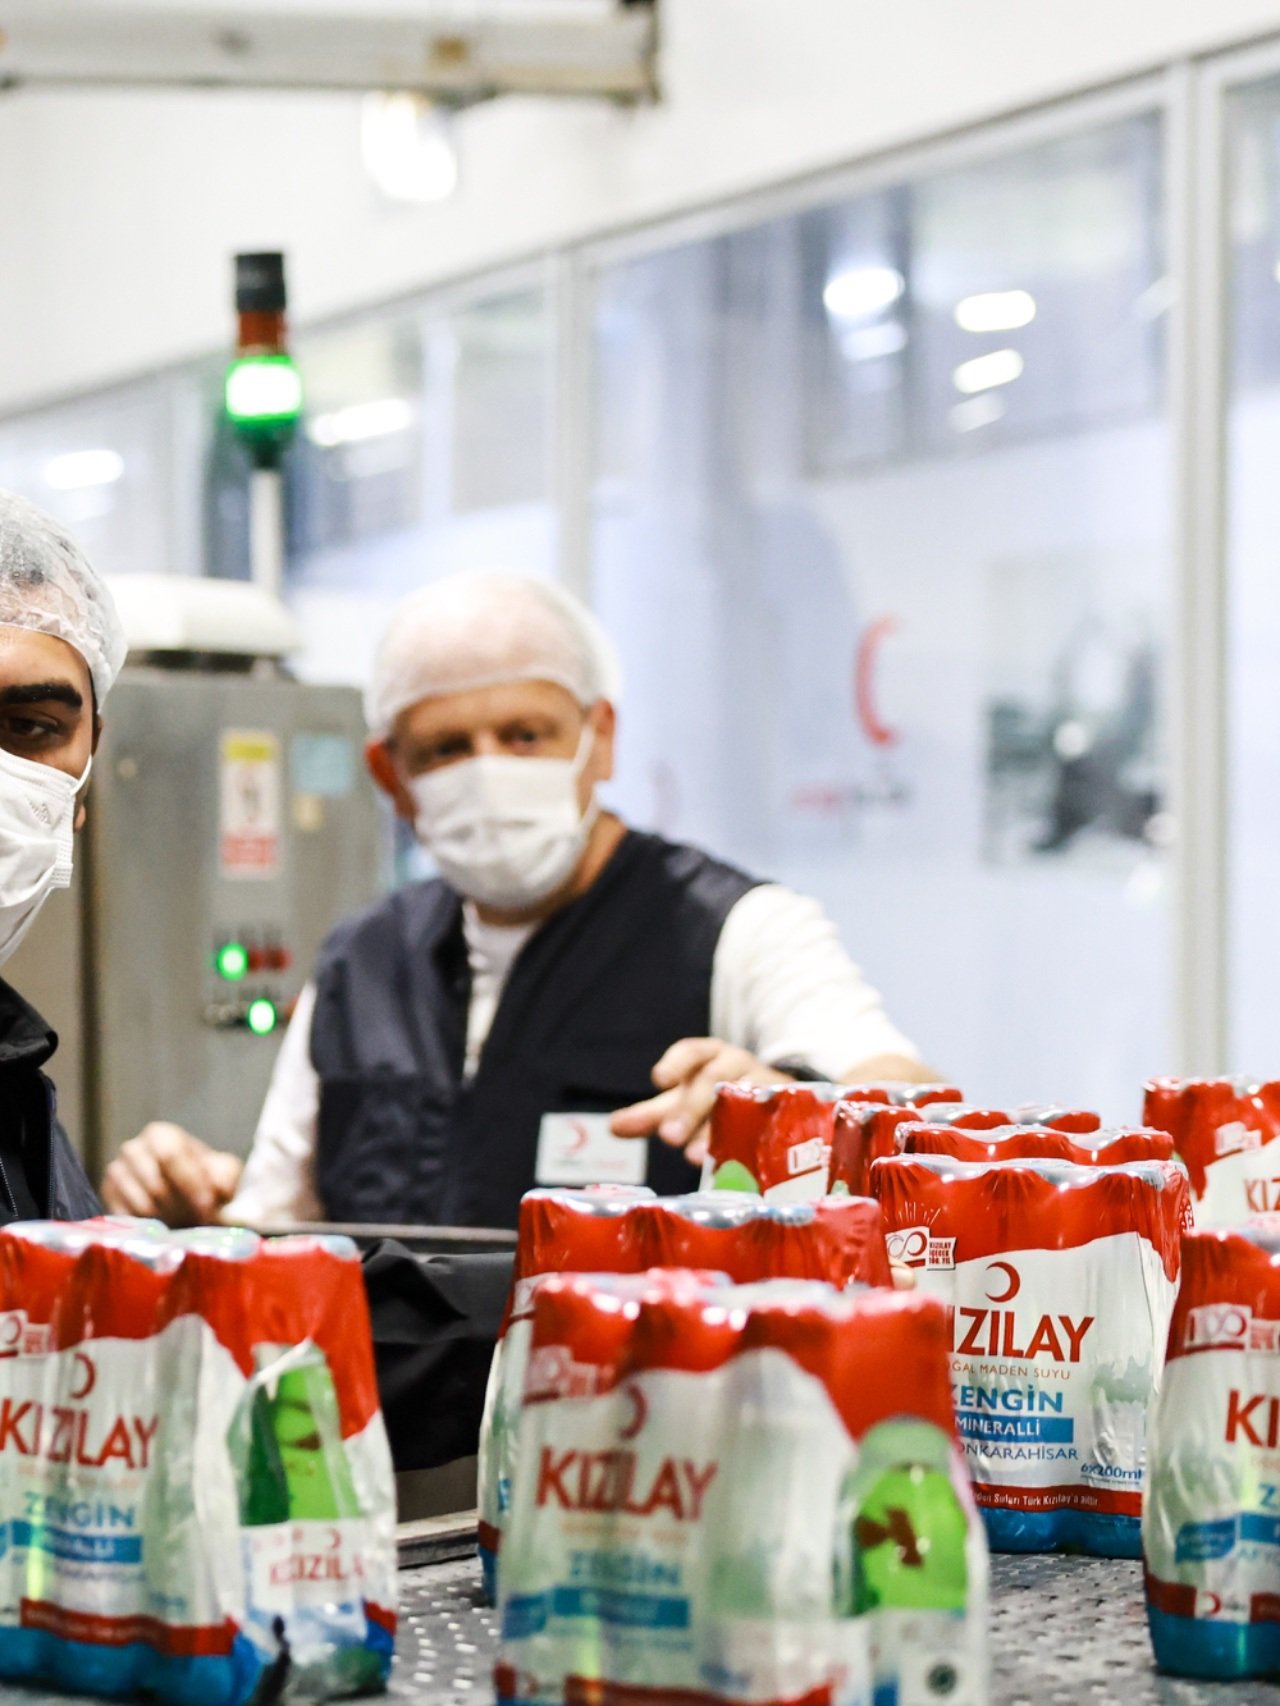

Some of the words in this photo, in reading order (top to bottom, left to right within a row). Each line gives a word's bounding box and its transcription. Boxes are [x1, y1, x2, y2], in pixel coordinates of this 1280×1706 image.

[946, 1305, 1095, 1363] IZILAY
[951, 1360, 976, 1375] ĞAL
[979, 1364, 1028, 1377] MADEN
[1033, 1368, 1071, 1380] SUYU
[536, 1445, 719, 1522] KIZILAY
[1023, 1494, 1041, 1506] Türk
